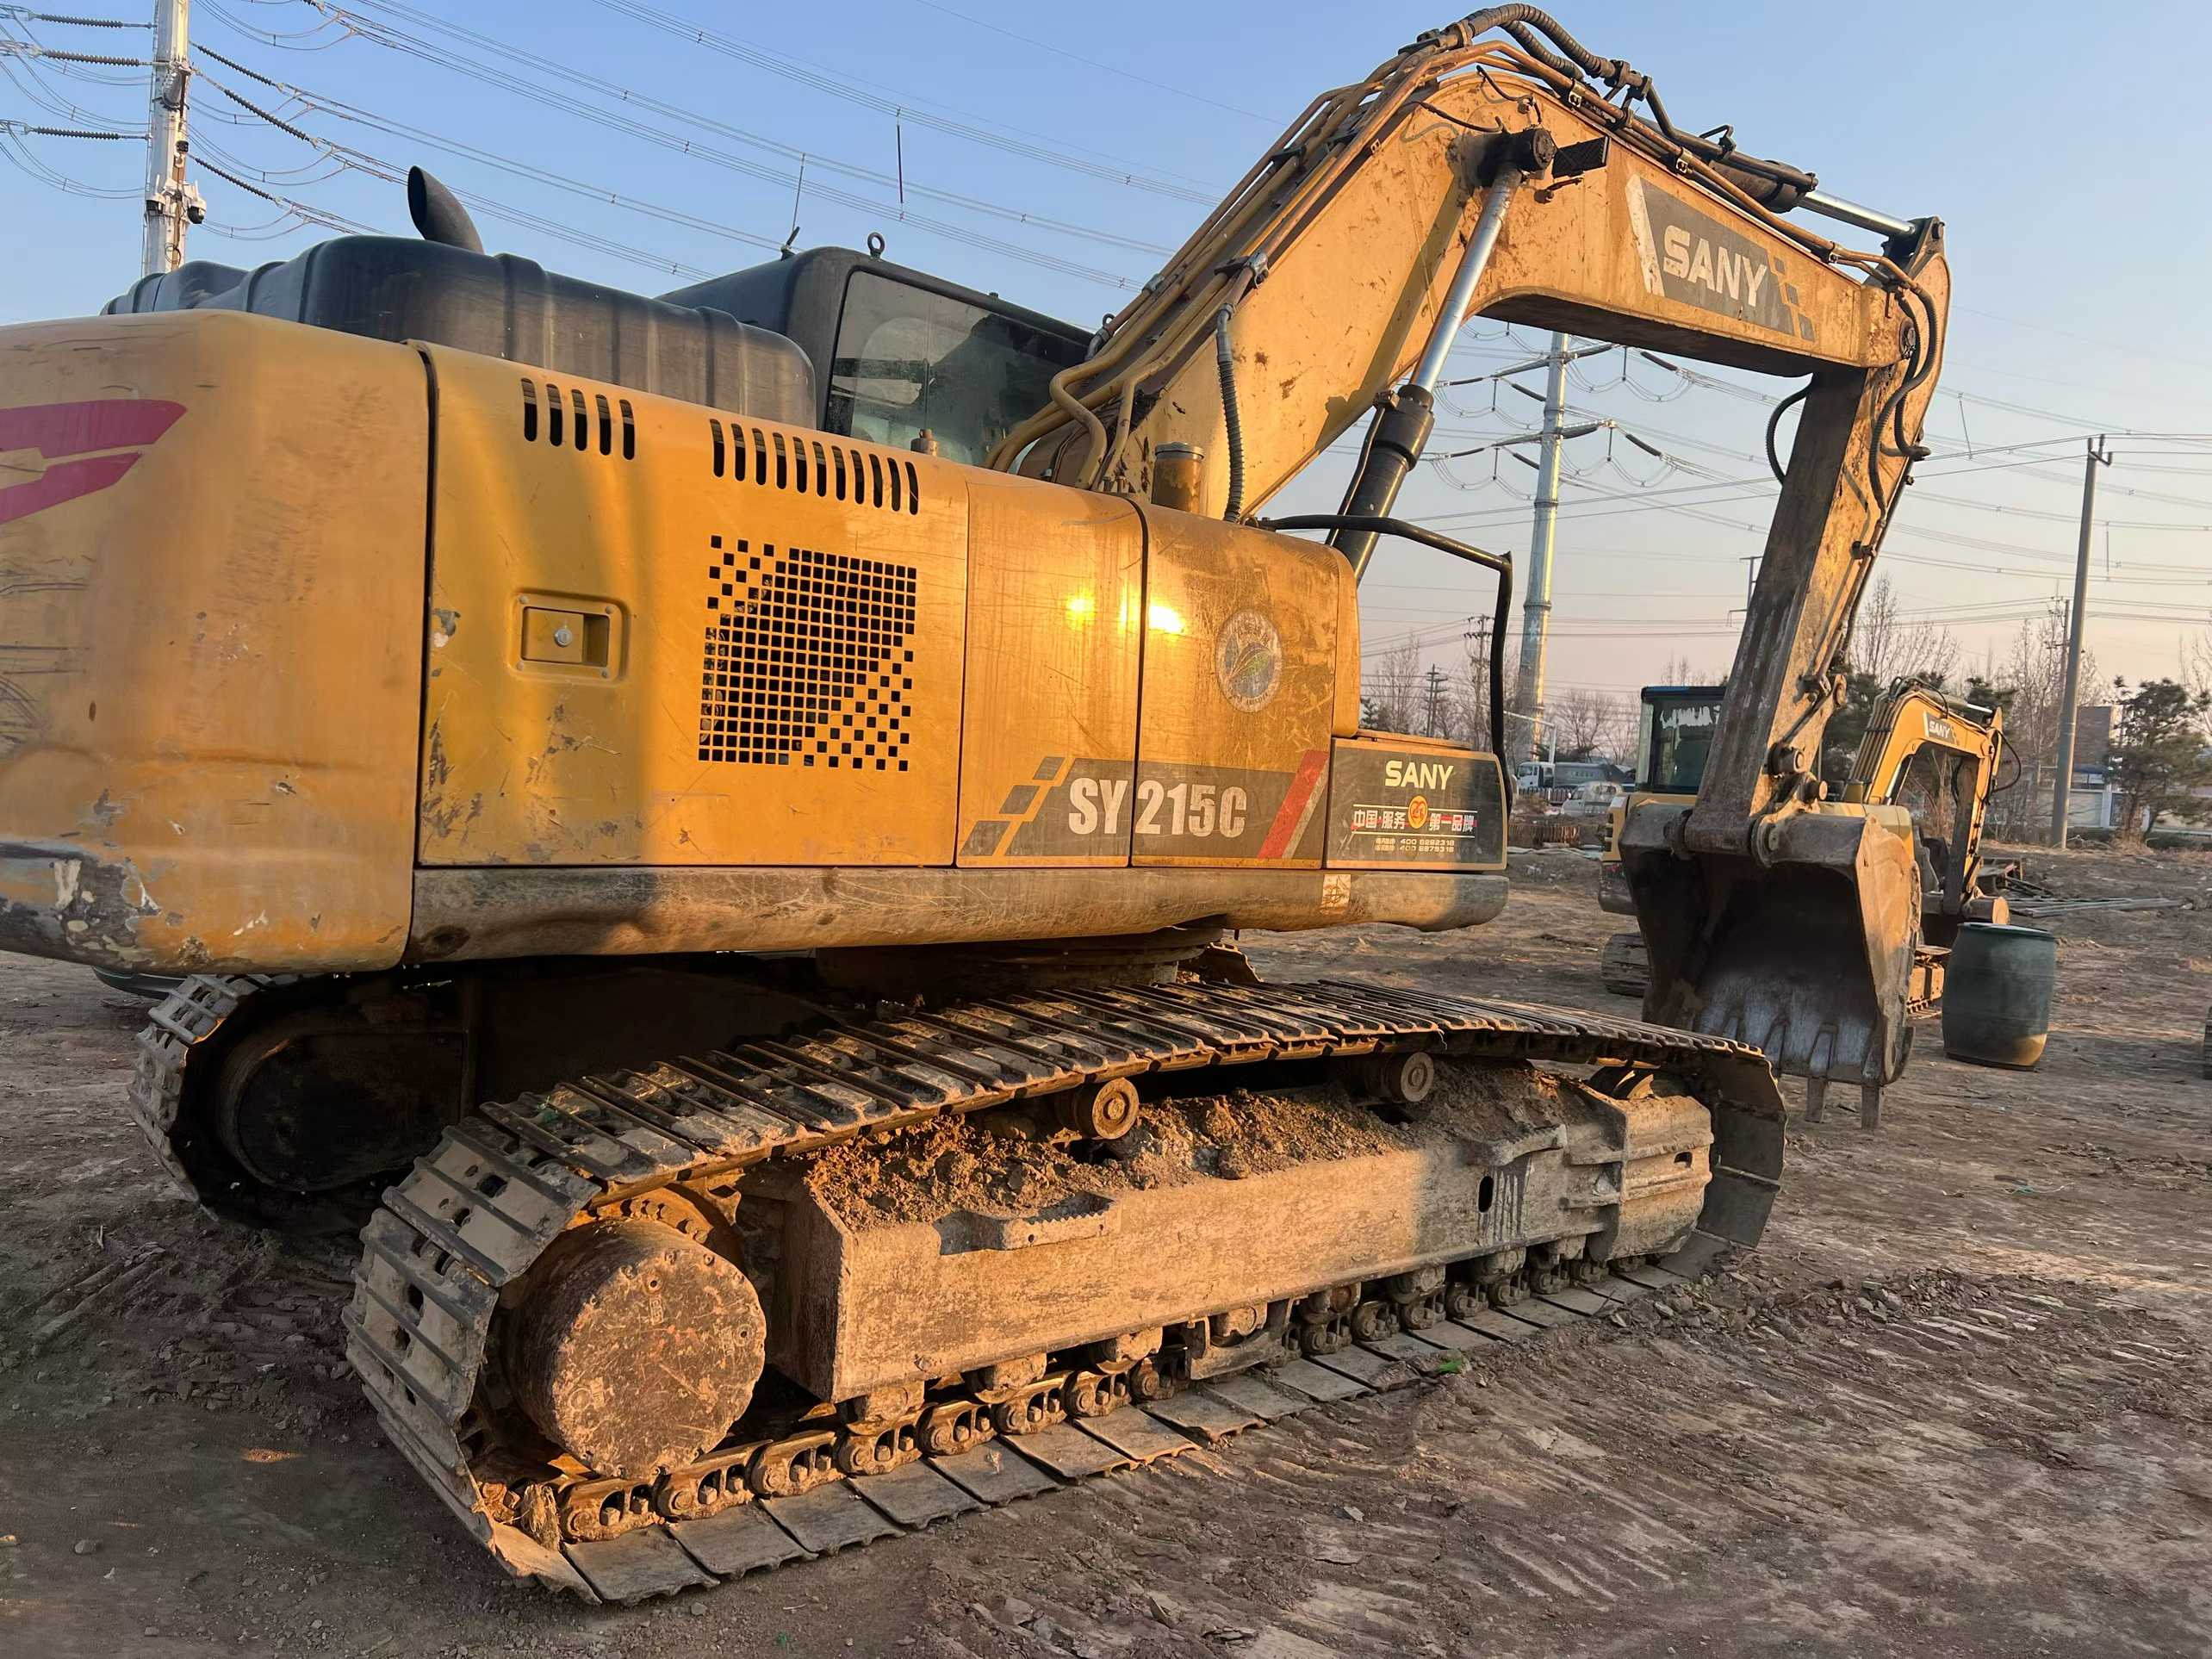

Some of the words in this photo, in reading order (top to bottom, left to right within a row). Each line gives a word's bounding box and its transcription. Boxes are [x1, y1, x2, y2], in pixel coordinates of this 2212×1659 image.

[1663, 225, 1768, 307] SANY
[1929, 720, 1950, 738] SANY
[1384, 760, 1455, 790] SANY
[1428, 812, 1475, 833] 第一品牌
